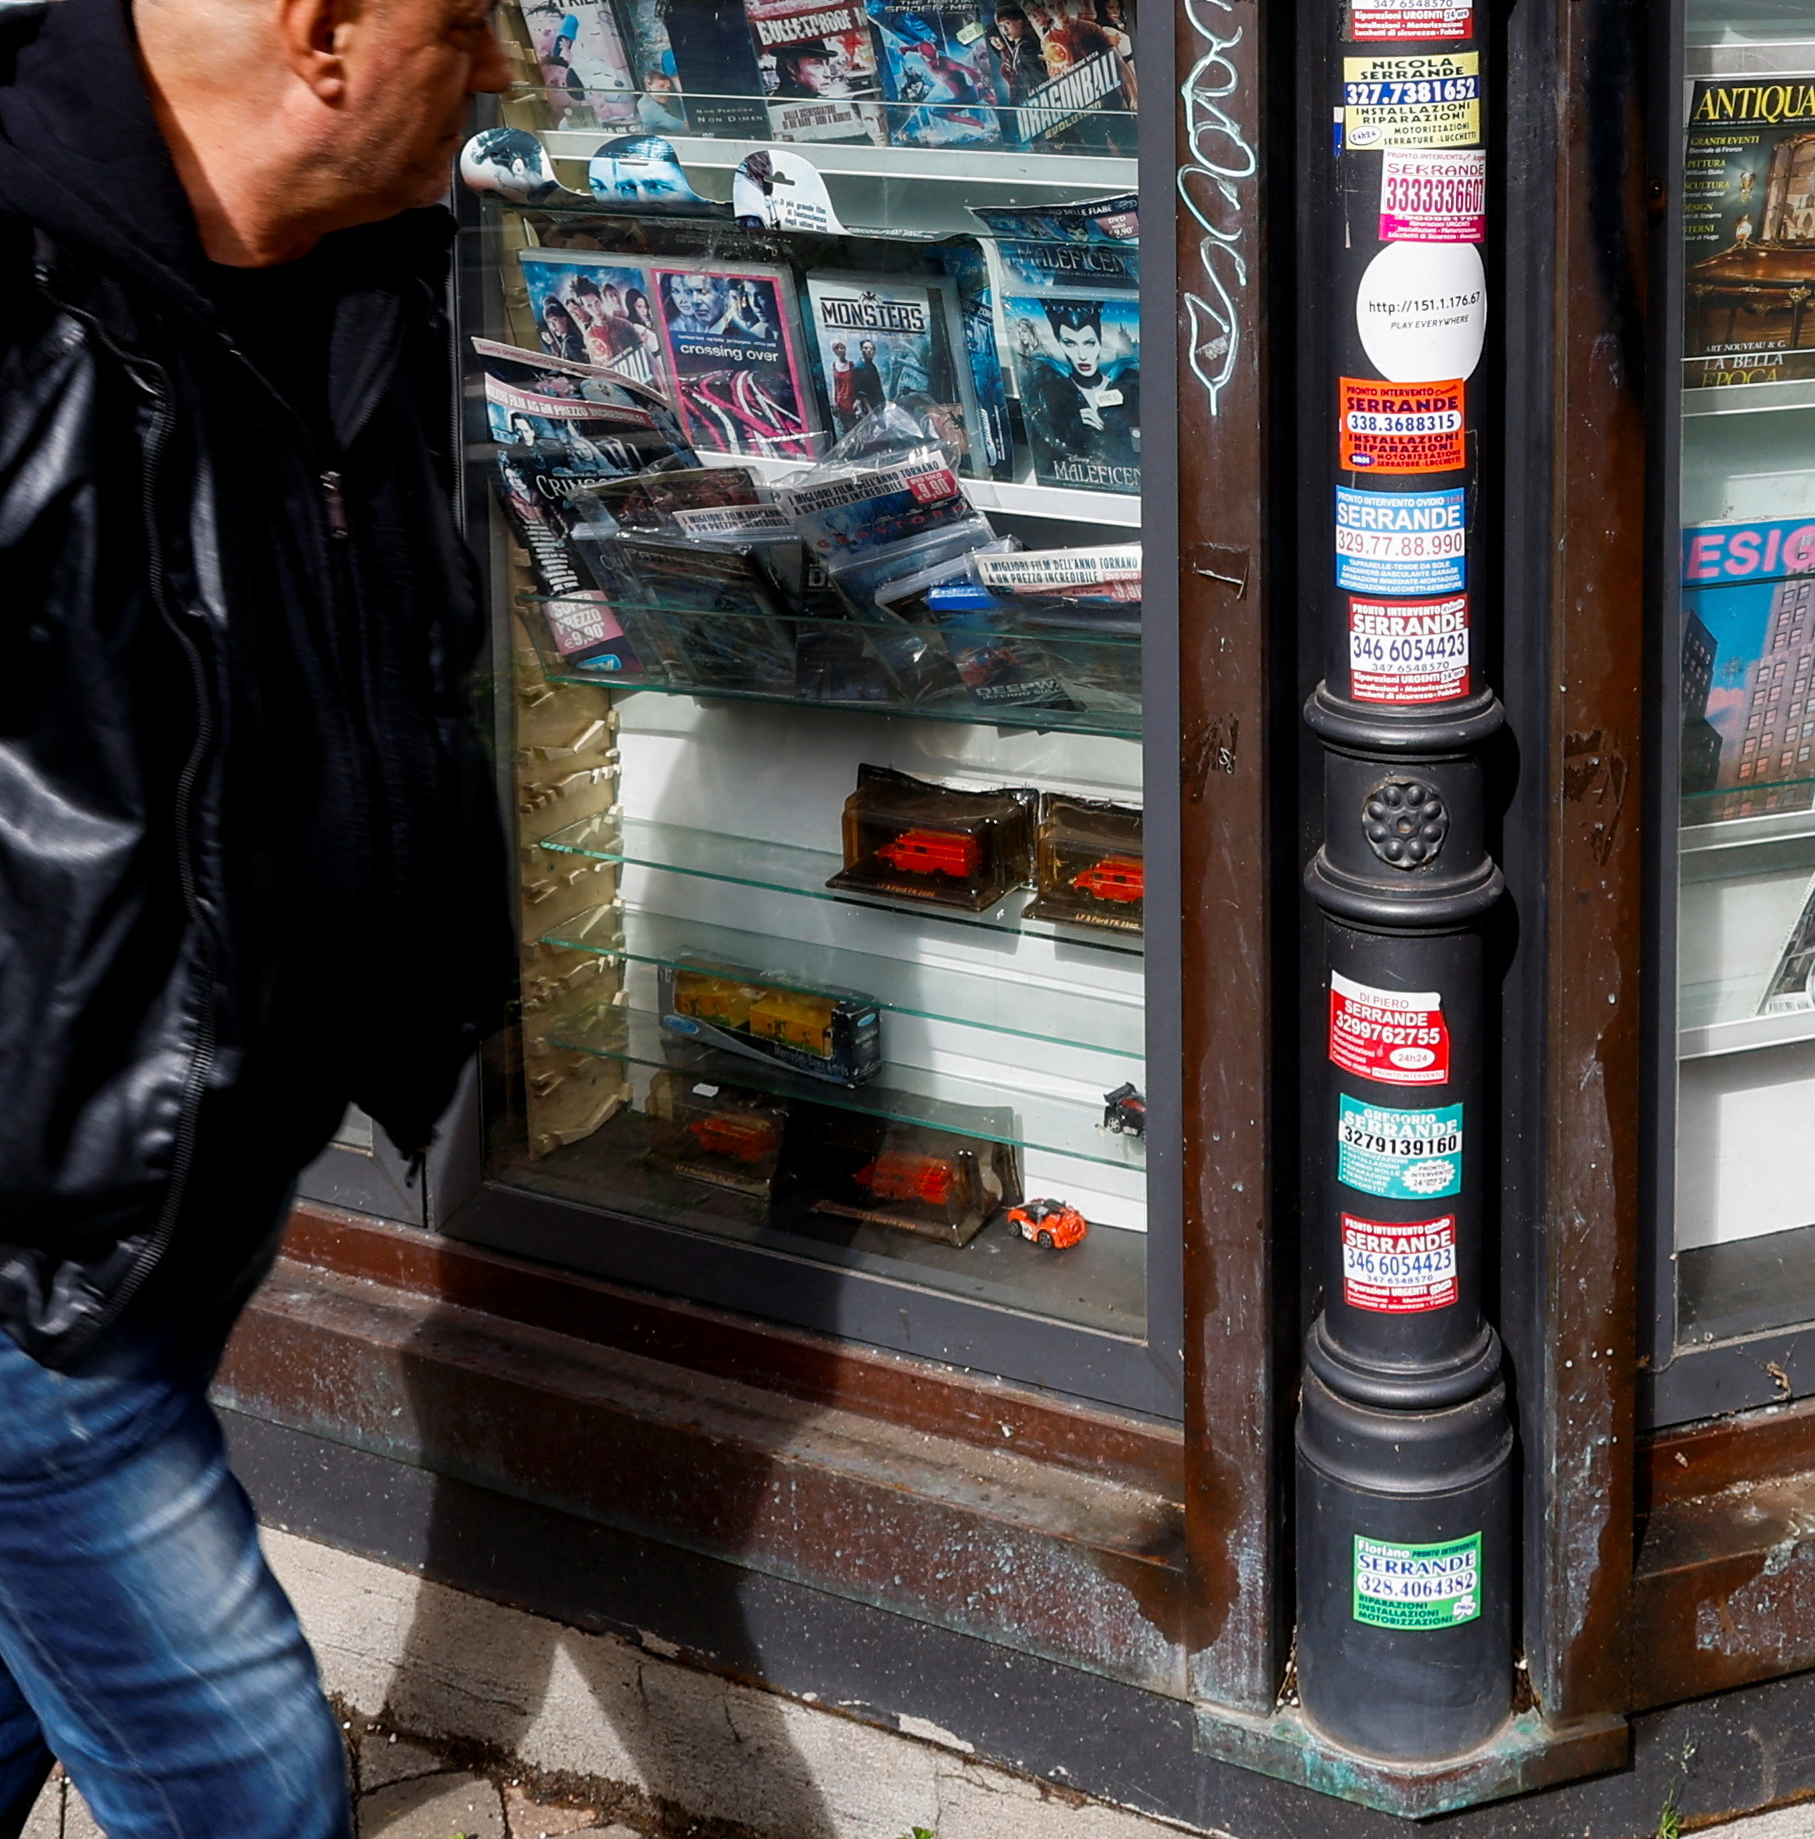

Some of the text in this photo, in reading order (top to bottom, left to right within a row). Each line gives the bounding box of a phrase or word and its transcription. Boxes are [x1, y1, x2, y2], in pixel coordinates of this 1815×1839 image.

[756, 7, 854, 47] BULLETPROOF
[1359, 66, 1465, 81] SERRANDE
[1371, 57, 1454, 71] NICOLA
[1017, 50, 1122, 143] DRAGONBALL
[1346, 77, 1476, 106] 327.7381652
[698, 115, 726, 124] NON
[1355, 101, 1471, 116] INSTALLAZIONI
[1362, 111, 1465, 125] RIPARAZIONI
[1692, 134, 1760, 146] GRANDI EVENTI
[1386, 162, 1485, 176] SERRANDE
[1090, 205, 1112, 215] FIABE
[820, 300, 926, 331] MONSTERS
[1368, 290, 1481, 316] http://151.1.176.67
[679, 342, 779, 363] crossing over
[1705, 341, 1777, 354] ART NOUVEAU &
[1704, 352, 1785, 371] LA BELLA
[1346, 395, 1459, 414] SERRANDE
[1351, 412, 1456, 432] 338.3688315
[794, 460, 941, 505] MIGLIORI FILM DELL'ANNO TORNANO
[816, 479, 906, 508] PREZZO INCREDIBILE
[1337, 502, 1461, 531] SERRANDE
[1337, 529, 1463, 557] 329.77.88.990
[990, 556, 1139, 574] MIGLIORI FILM DELL'ANNO TORNANO
[996, 570, 1098, 584] UN PREZZO INCREDIBILE
[557, 608, 601, 637] PREZZO
[1352, 610, 1465, 636] SERRANDE
[1352, 634, 1465, 663] 346 6054423
[1344, 999, 1429, 1028] SERRANDE
[1359, 991, 1409, 1010] DI PIERO
[1336, 1010, 1441, 1046] 3299762755
[1344, 1109, 1458, 1139] SERRANDE
[1344, 1124, 1458, 1157] 3279139160
[1345, 1229, 1452, 1255] SERRANDE
[1347, 1247, 1453, 1276] 346 6054423
[1358, 1539, 1410, 1558] Floriano
[1357, 1550, 1475, 1576] SERRANDE
[1359, 1570, 1474, 1599] 328.4064382
[1358, 1593, 1428, 1610] RIPARAZIONI
[1358, 1602, 1440, 1618] INSTALLAZIONI
